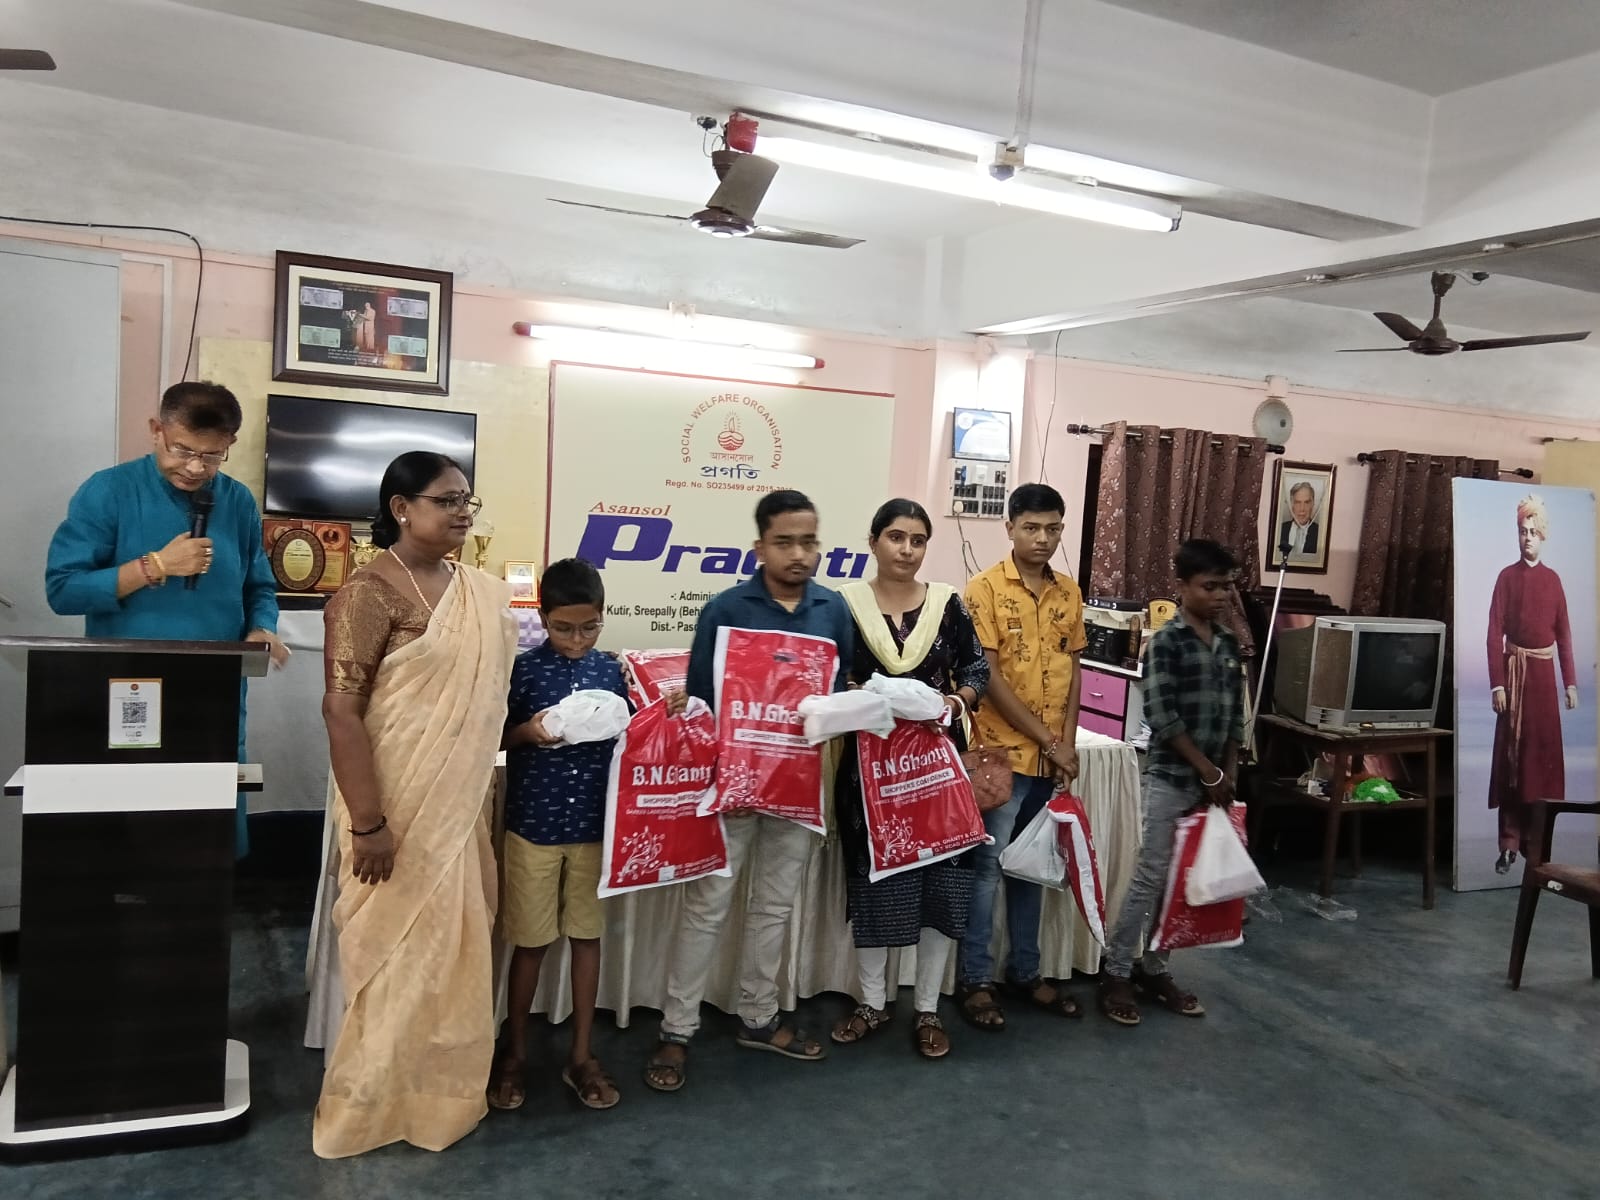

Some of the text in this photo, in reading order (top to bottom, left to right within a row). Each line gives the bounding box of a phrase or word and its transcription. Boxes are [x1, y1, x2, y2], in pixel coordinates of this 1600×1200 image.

[681, 394, 782, 470] SOCIAL WELFARE ORGANISATION
[700, 463, 760, 479] প্রগতি
[706, 481, 745, 491] SO235499
[588, 501, 671, 516] Asansol
[606, 604, 631, 617] Kutir,
[634, 605, 677, 618] Sreepally
[872, 746, 951, 780] B.N.Ghanty
